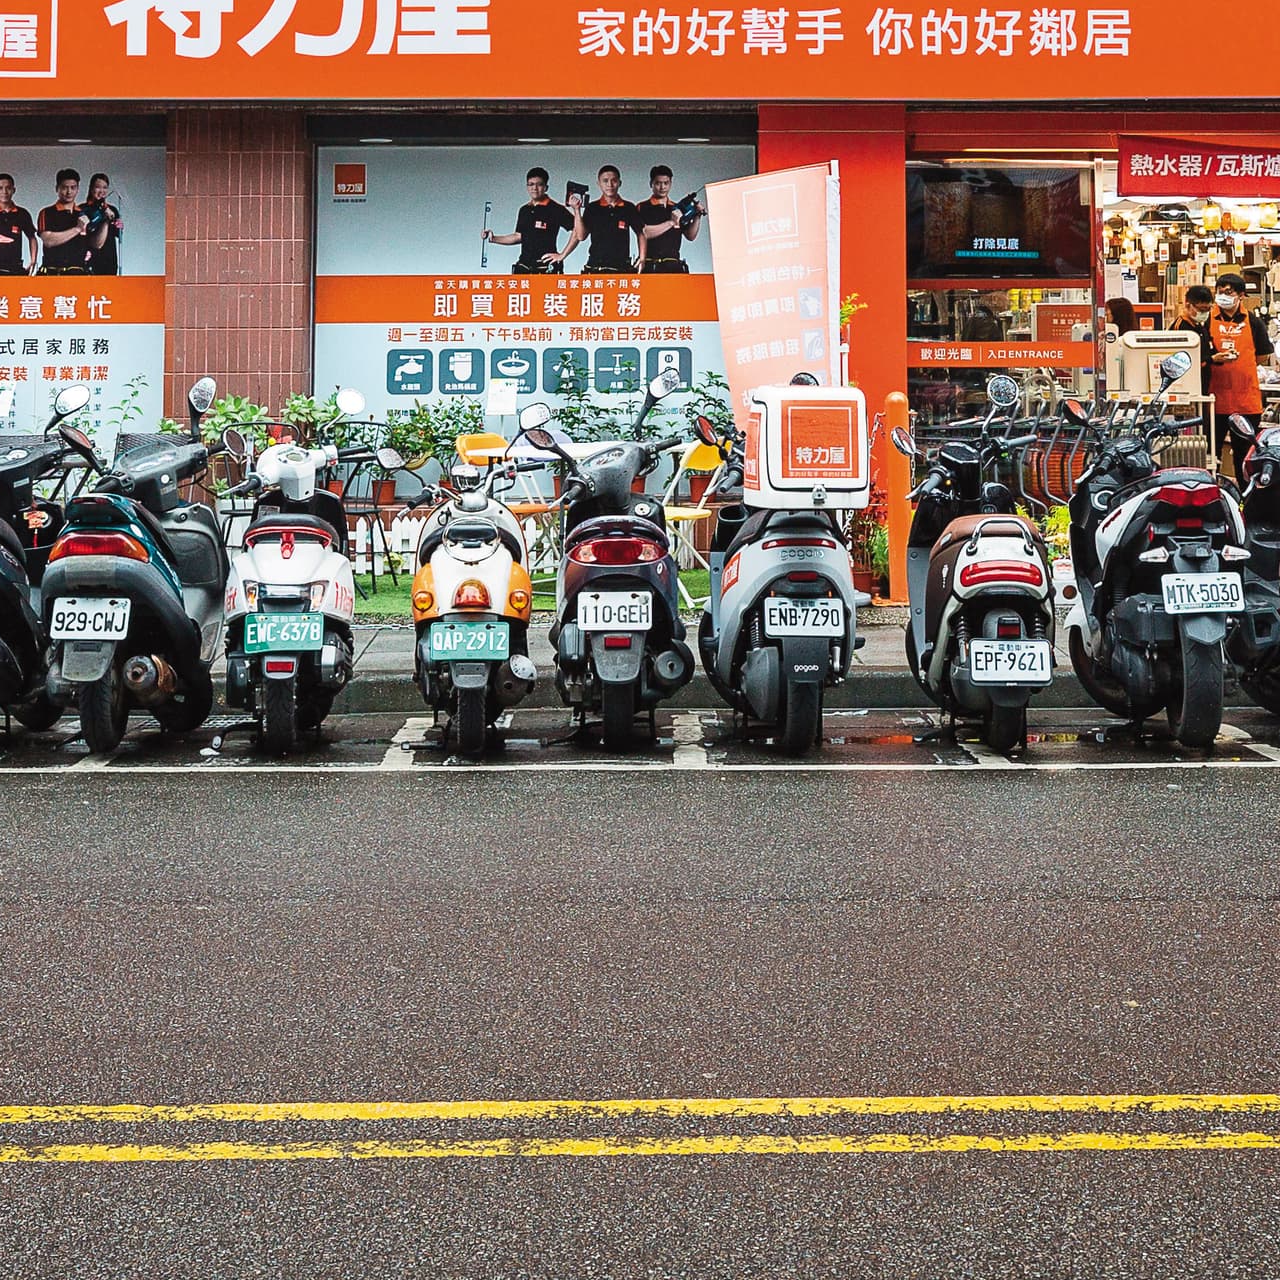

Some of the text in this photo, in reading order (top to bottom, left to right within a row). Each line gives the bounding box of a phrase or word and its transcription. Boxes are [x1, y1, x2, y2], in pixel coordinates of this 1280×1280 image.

[577, 6, 1132, 57] 家的好幫手 你的好鄰居
[433, 279, 532, 290] 當天購買當天安裝
[433, 293, 642, 317] 即買即裝服務
[921, 347, 973, 361] 歡迎光臨
[796, 447, 845, 464] 特力屋
